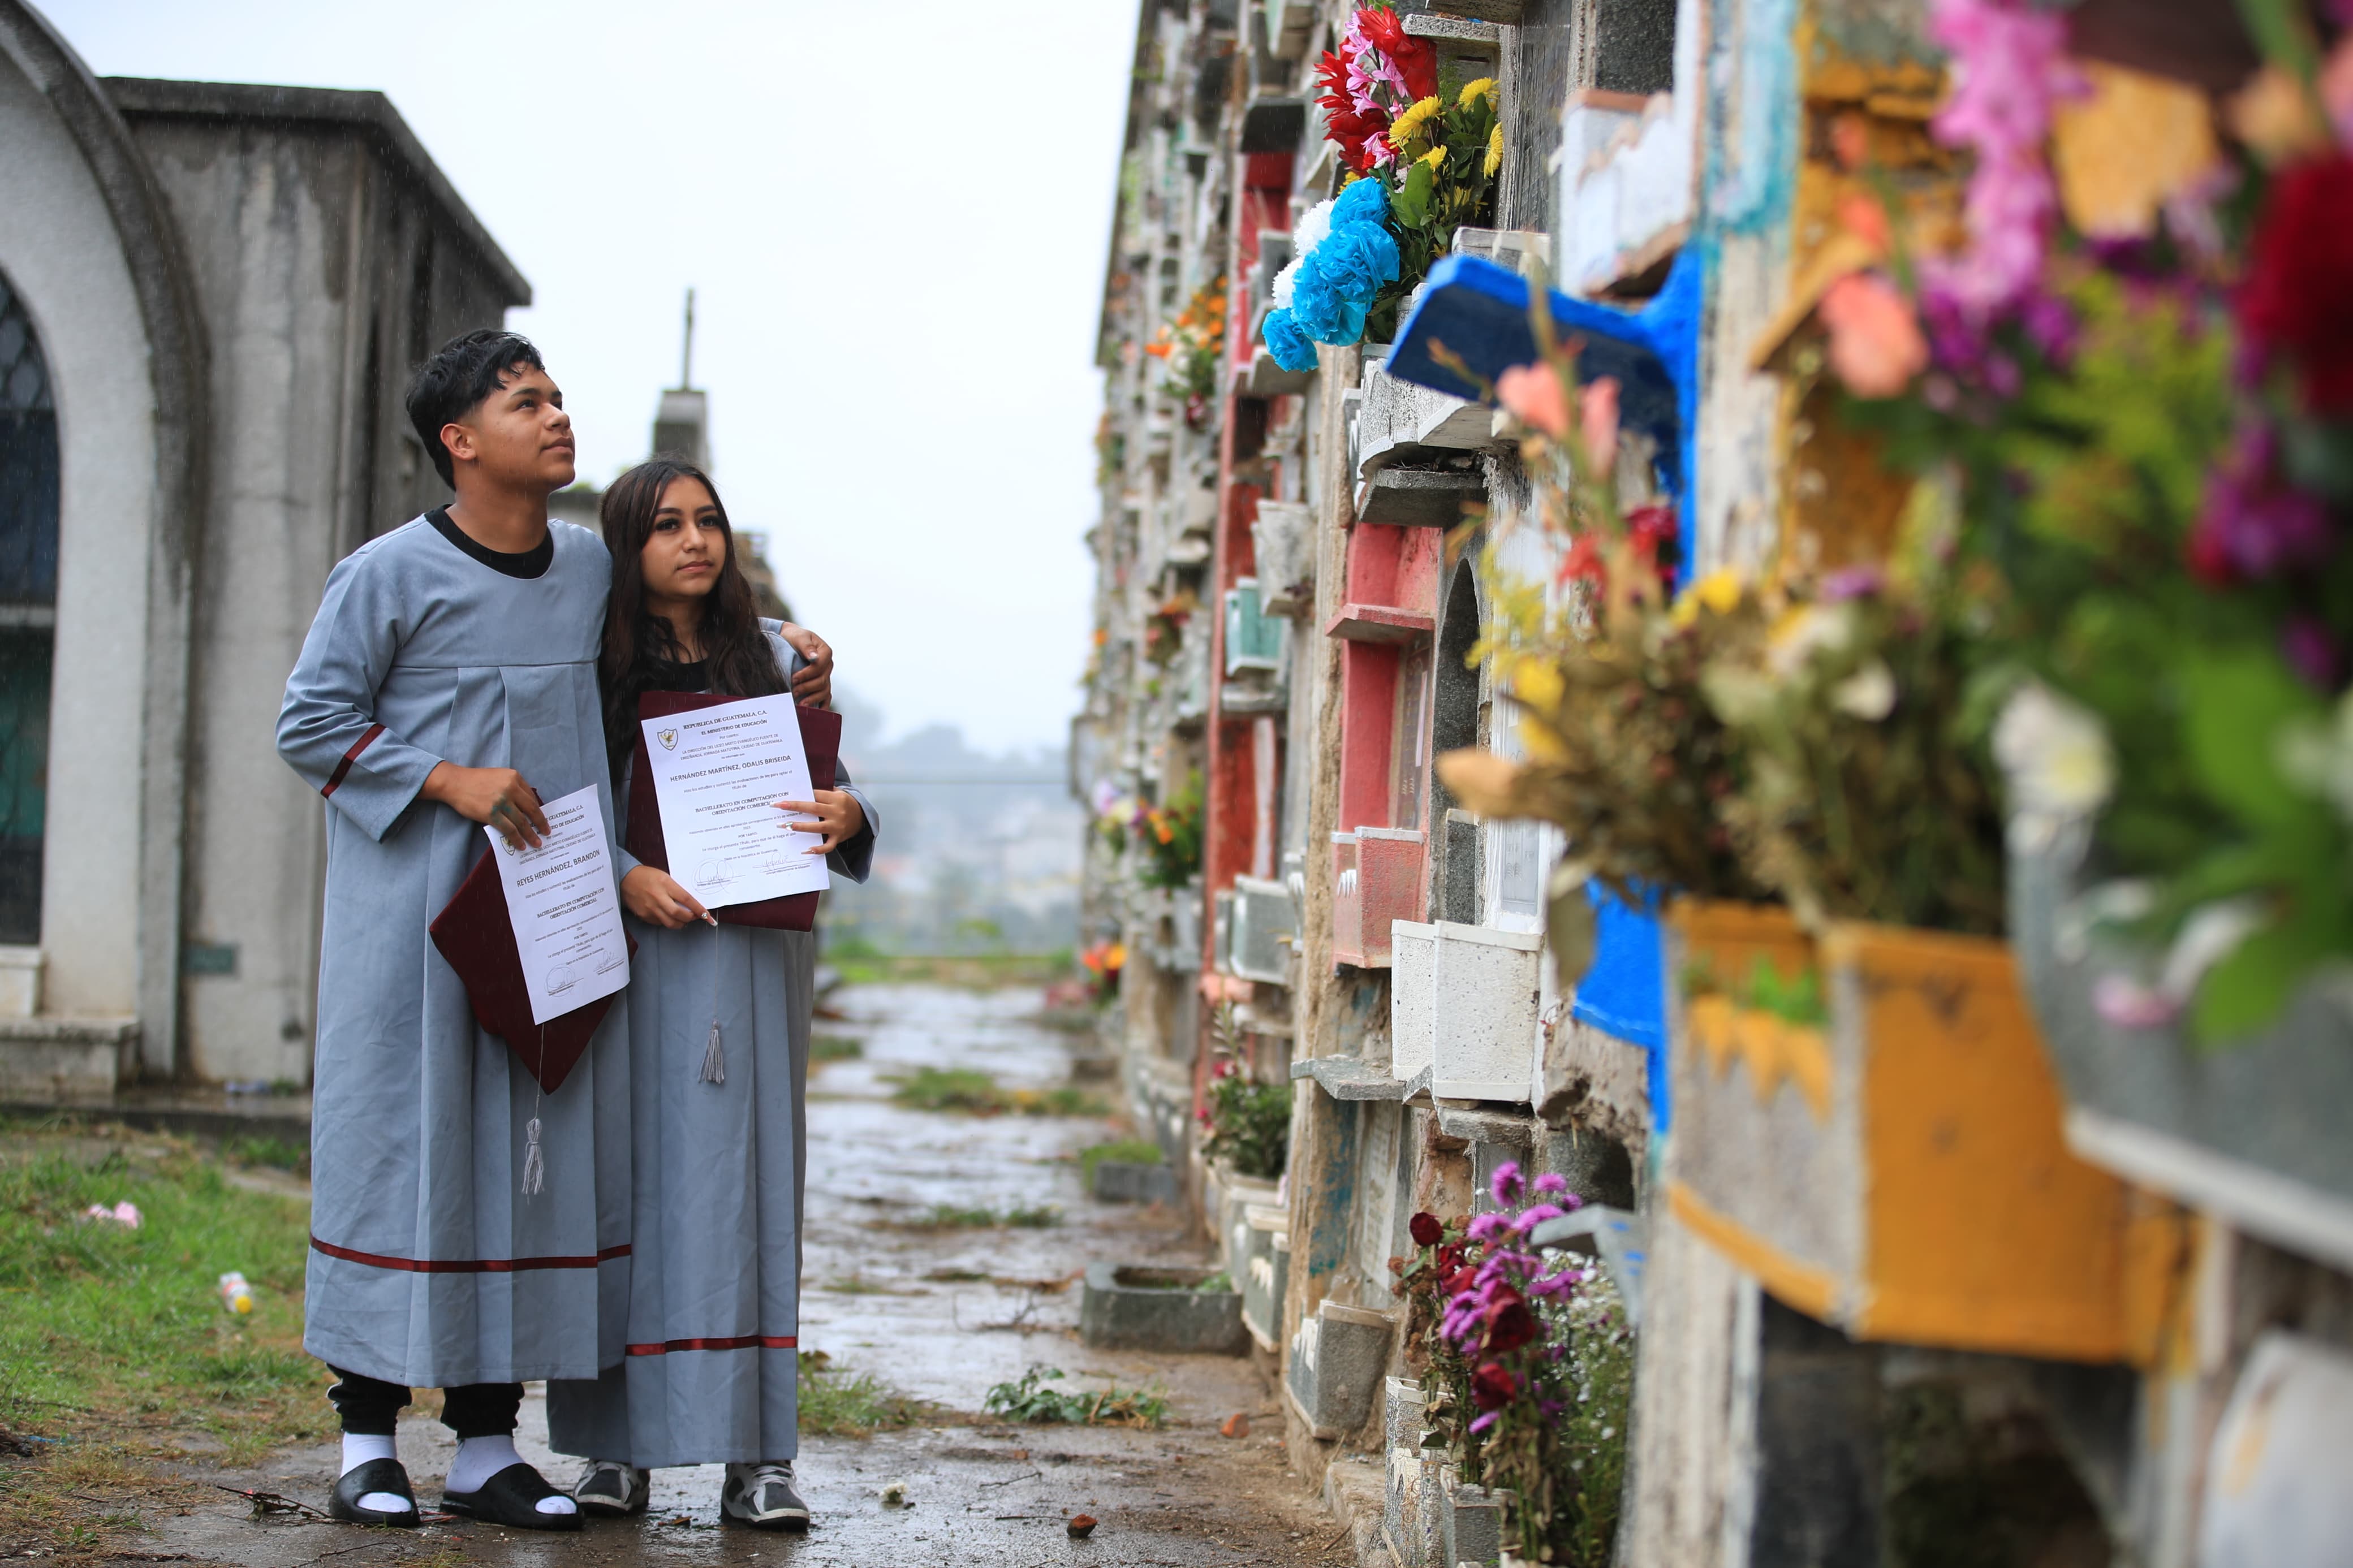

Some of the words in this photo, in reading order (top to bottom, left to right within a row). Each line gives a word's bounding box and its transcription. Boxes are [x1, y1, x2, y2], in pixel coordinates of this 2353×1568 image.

[722, 712, 757, 722] GUATEMALA,
[707, 725, 734, 734] MINISTERIO
[670, 770, 707, 781] HERNÁNDEZ
[708, 764, 741, 775] MARTÍNEZ,
[742, 760, 764, 768] ODALIS
[765, 755, 791, 764] BRISEIDA
[695, 802, 733, 813] BACHILLERATO
[741, 793, 777, 804] COMPUTACIÓN
[712, 805, 745, 815] ORIENTACIÓN
[565, 815, 584, 825] EDUCACIÓN
[516, 875, 533, 887] REYES
[535, 860, 572, 880] HERNÁNDEZ,
[573, 849, 600, 865] BRANDON
[537, 903, 566, 918] BACHILLERATO
[572, 890, 598, 904] COMPUTACIÓN
[550, 905, 576, 920] ORIENTACIÓN
